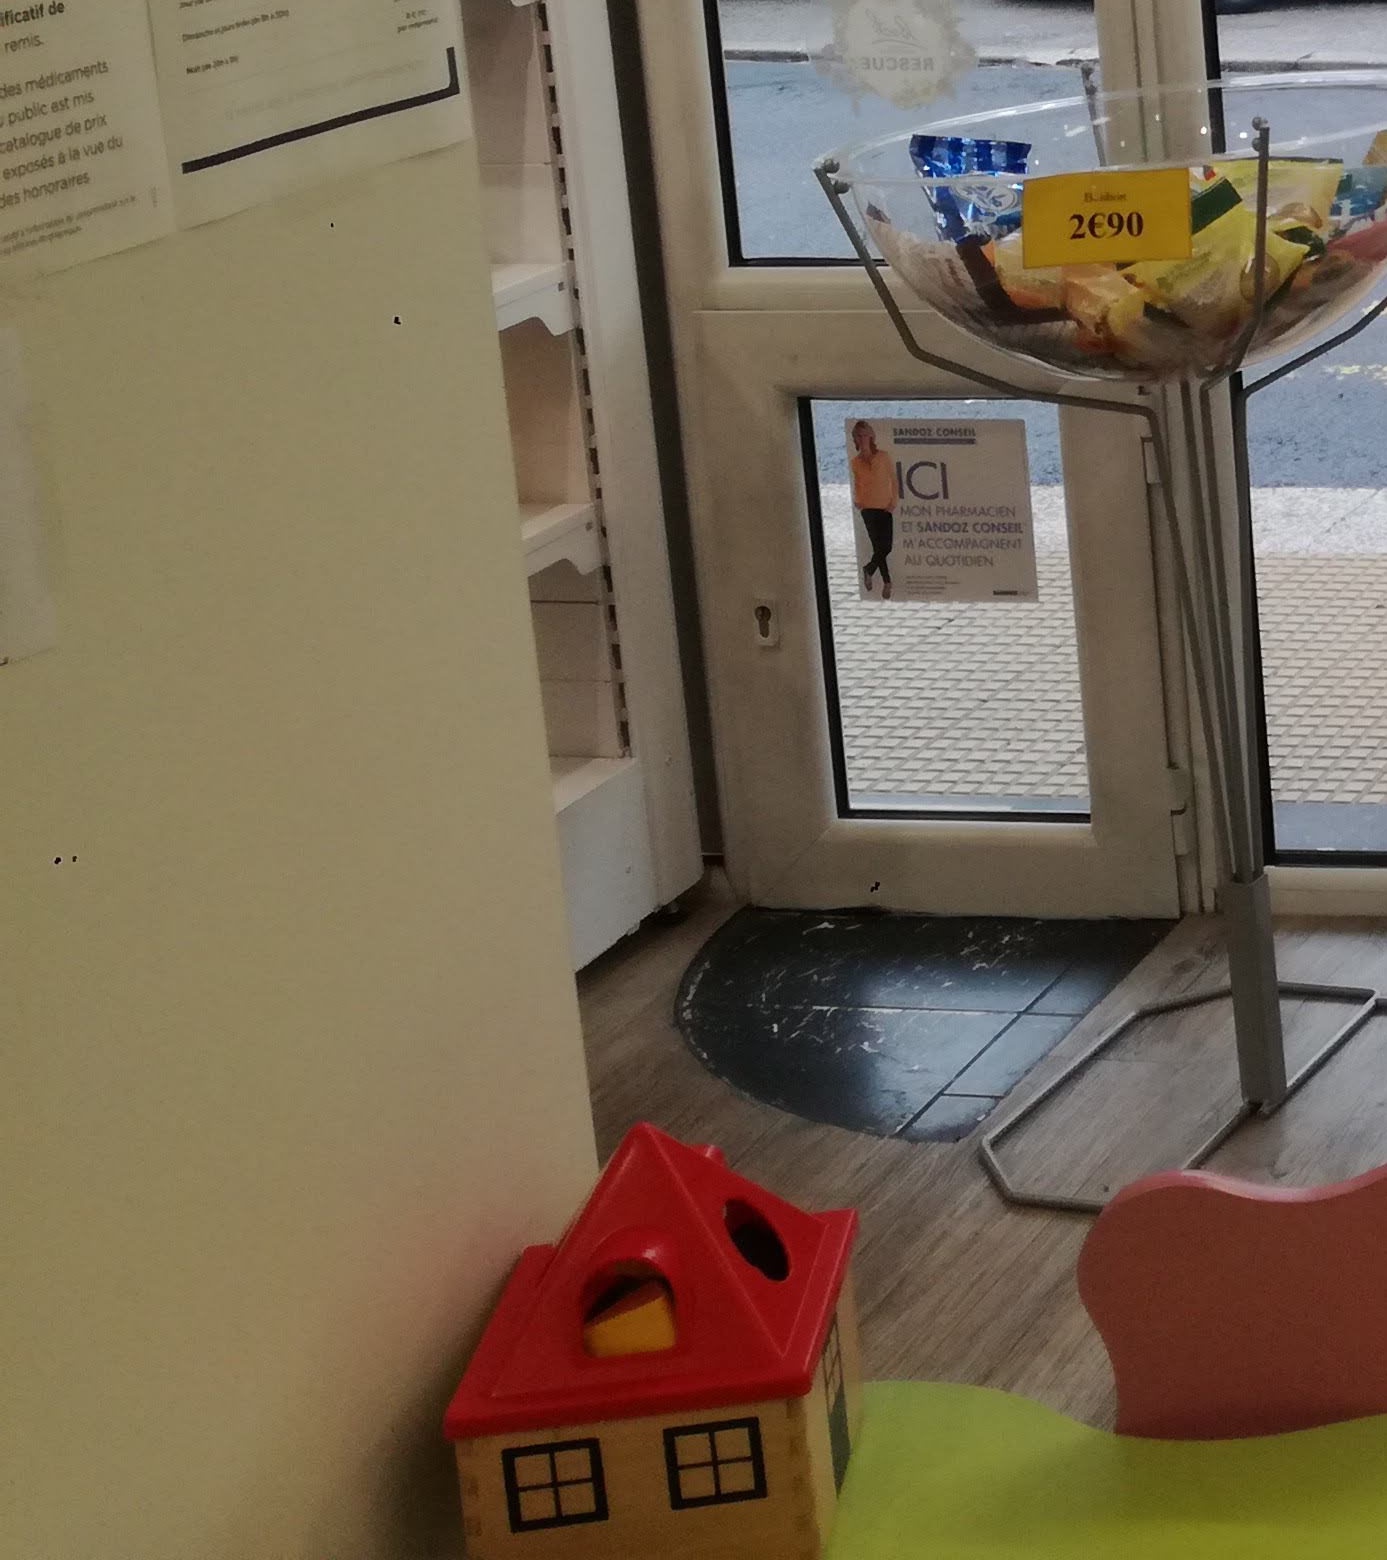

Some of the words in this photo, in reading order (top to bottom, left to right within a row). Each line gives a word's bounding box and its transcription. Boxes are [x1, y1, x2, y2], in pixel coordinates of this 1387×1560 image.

[47, 0, 66, 15] de
[25, 59, 109, 92] médicaments
[8, 99, 49, 127] public
[73, 90, 95, 108] mis
[1068, 209, 1145, 240] 2€90
[895, 460, 949, 501] ICI
[901, 505, 932, 517] MON
[935, 505, 1016, 518] PHARMACIEN
[902, 522, 913, 533] ET
[916, 522, 969, 533] SANDOZ
[972, 522, 1024, 534] CONSEIL
[904, 555, 922, 567] AU
[925, 554, 994, 568] QUOTIDIEN
